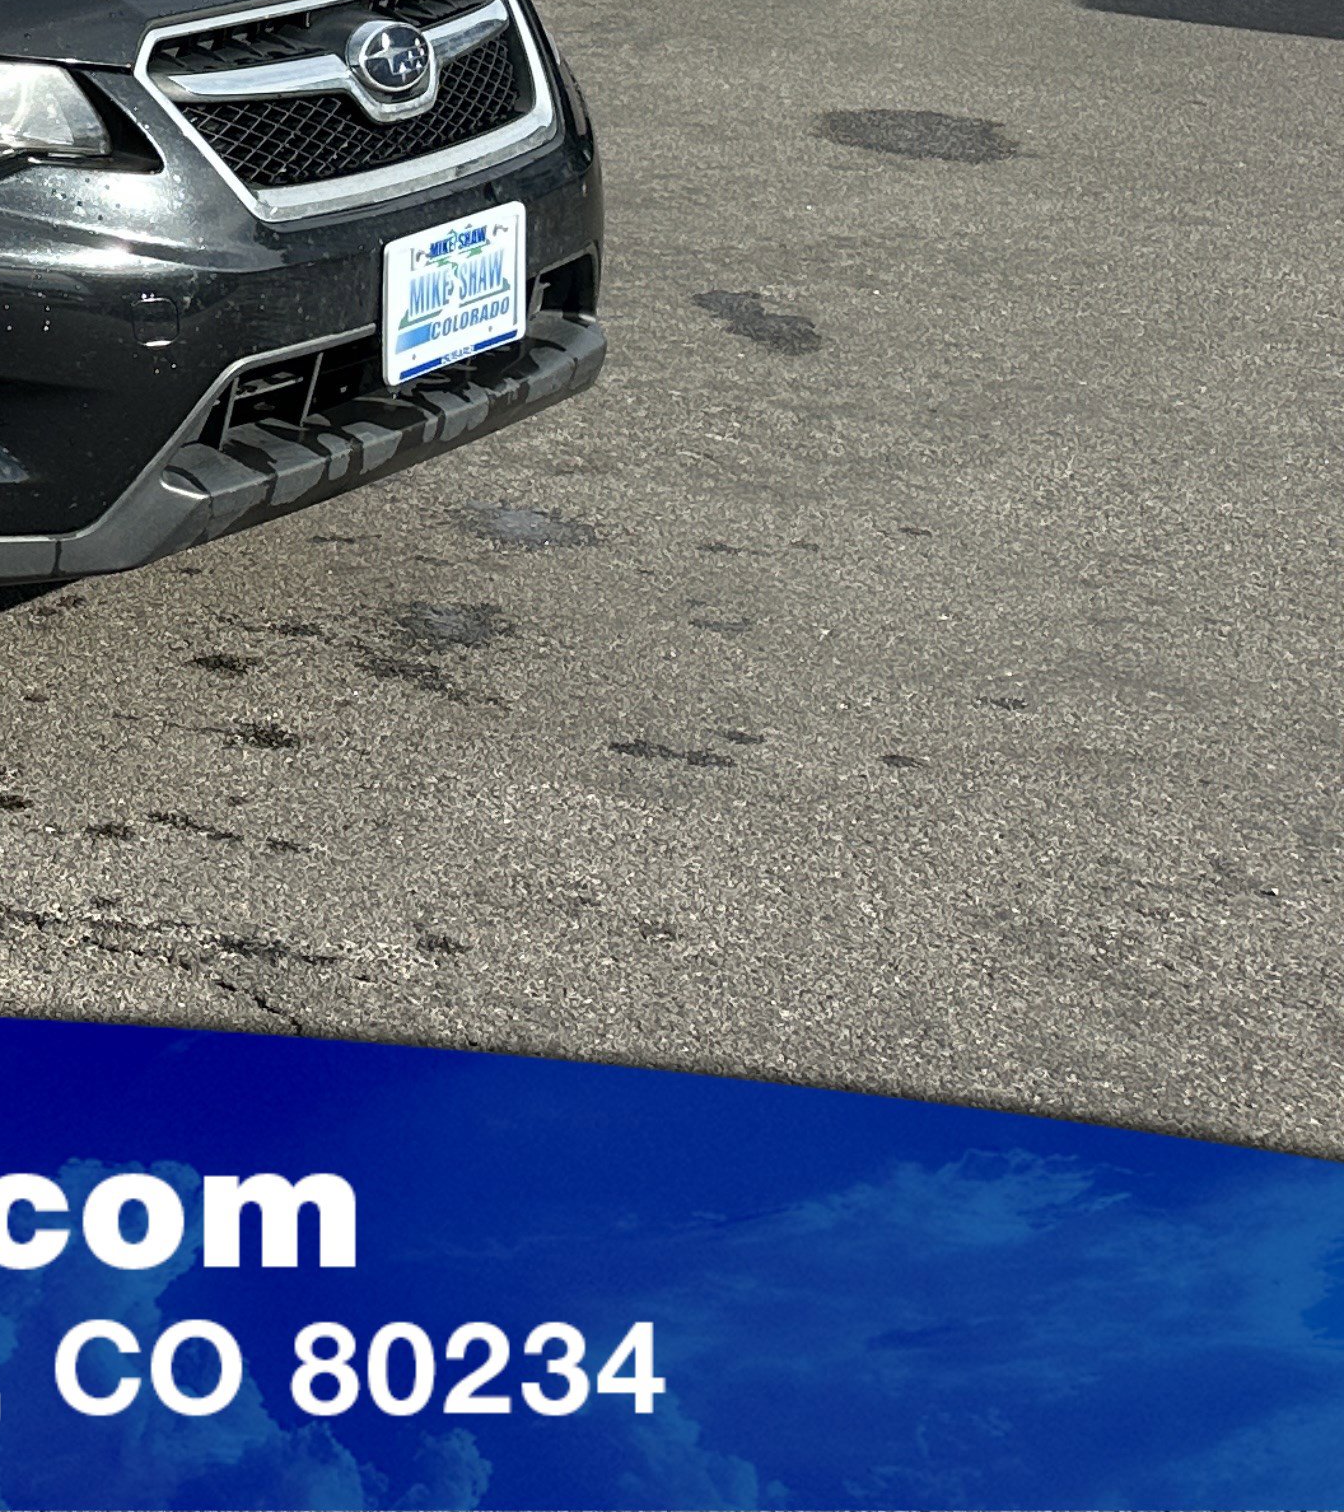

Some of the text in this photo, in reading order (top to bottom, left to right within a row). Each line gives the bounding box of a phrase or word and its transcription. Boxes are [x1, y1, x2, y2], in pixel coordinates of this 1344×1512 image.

[429, 225, 488, 258] MIKE SHAW
[409, 249, 505, 318] MIKE SHAW
[430, 295, 510, 341] COLORADO
